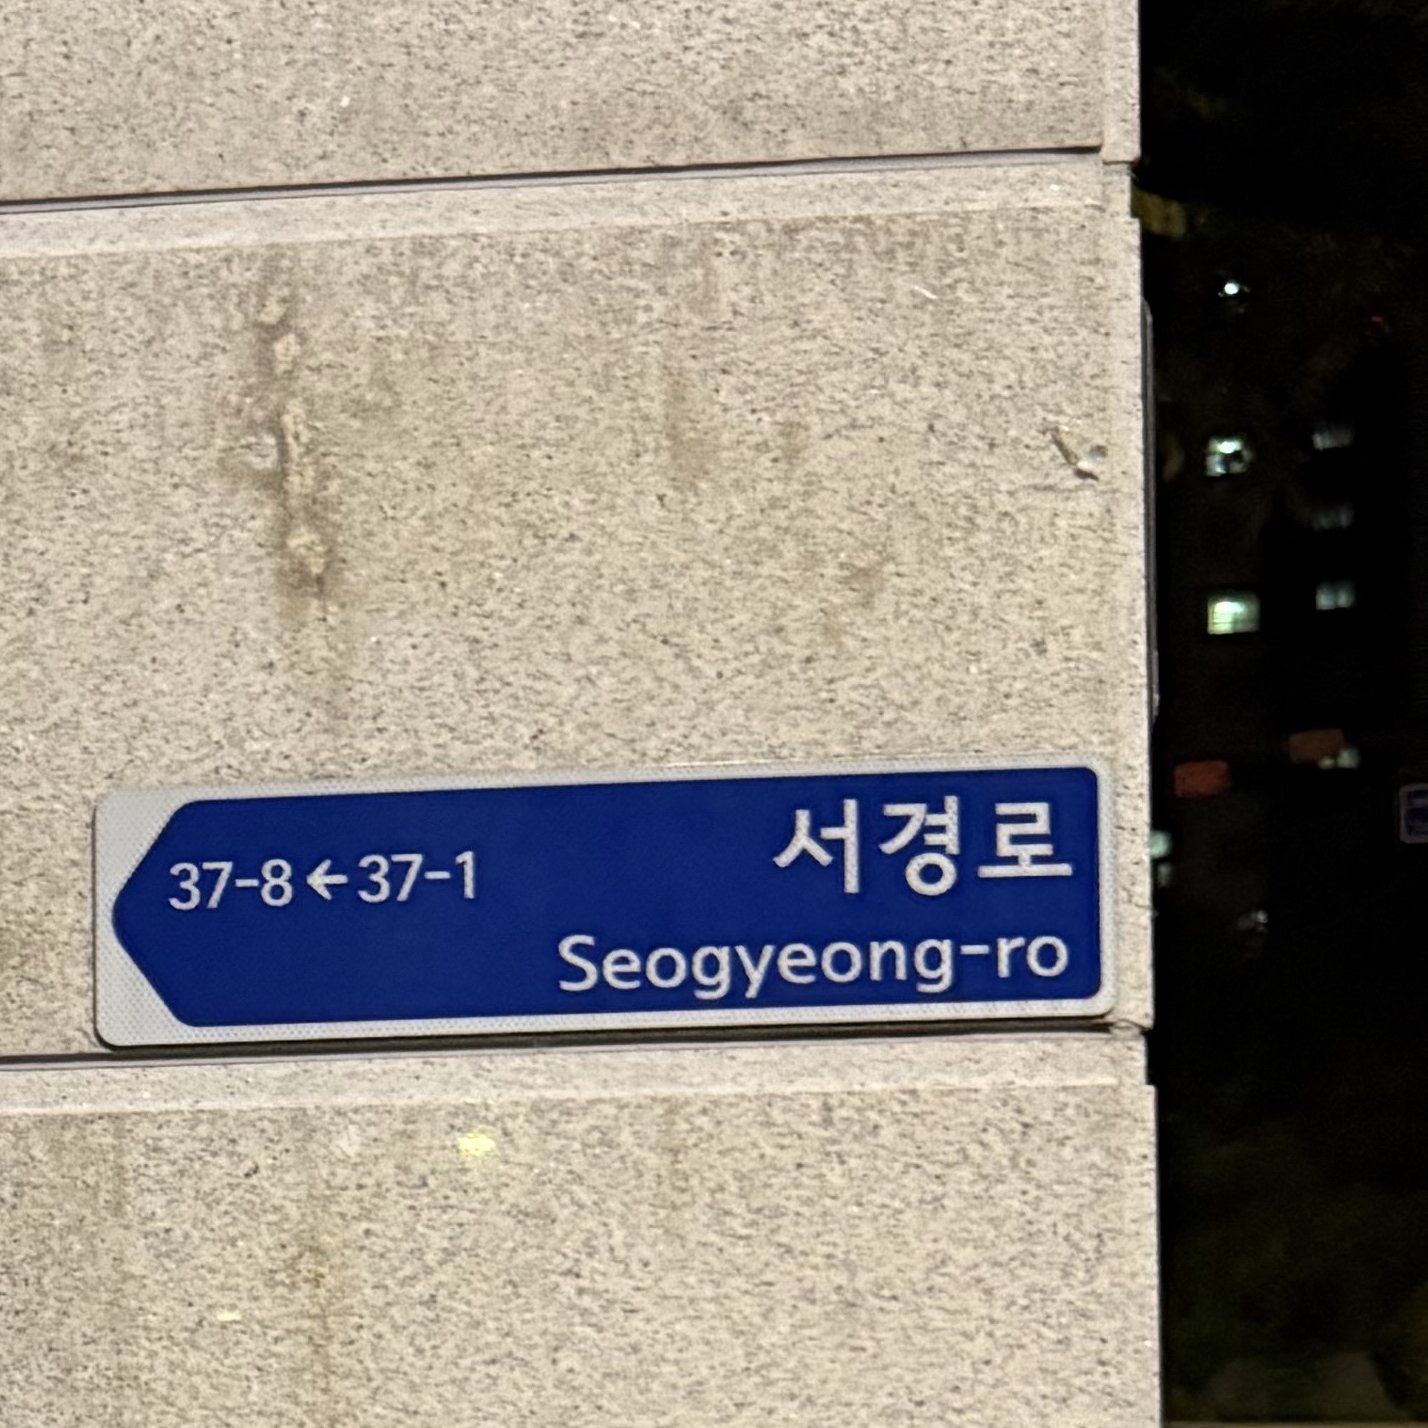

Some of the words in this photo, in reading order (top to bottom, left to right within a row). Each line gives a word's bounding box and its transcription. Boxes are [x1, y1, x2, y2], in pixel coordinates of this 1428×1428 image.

[167, 858, 294, 911] 37-8
[356, 850, 479, 905] 37-1
[772, 795, 1073, 895] 서경로
[556, 928, 1070, 999] Seogyeong-ro
